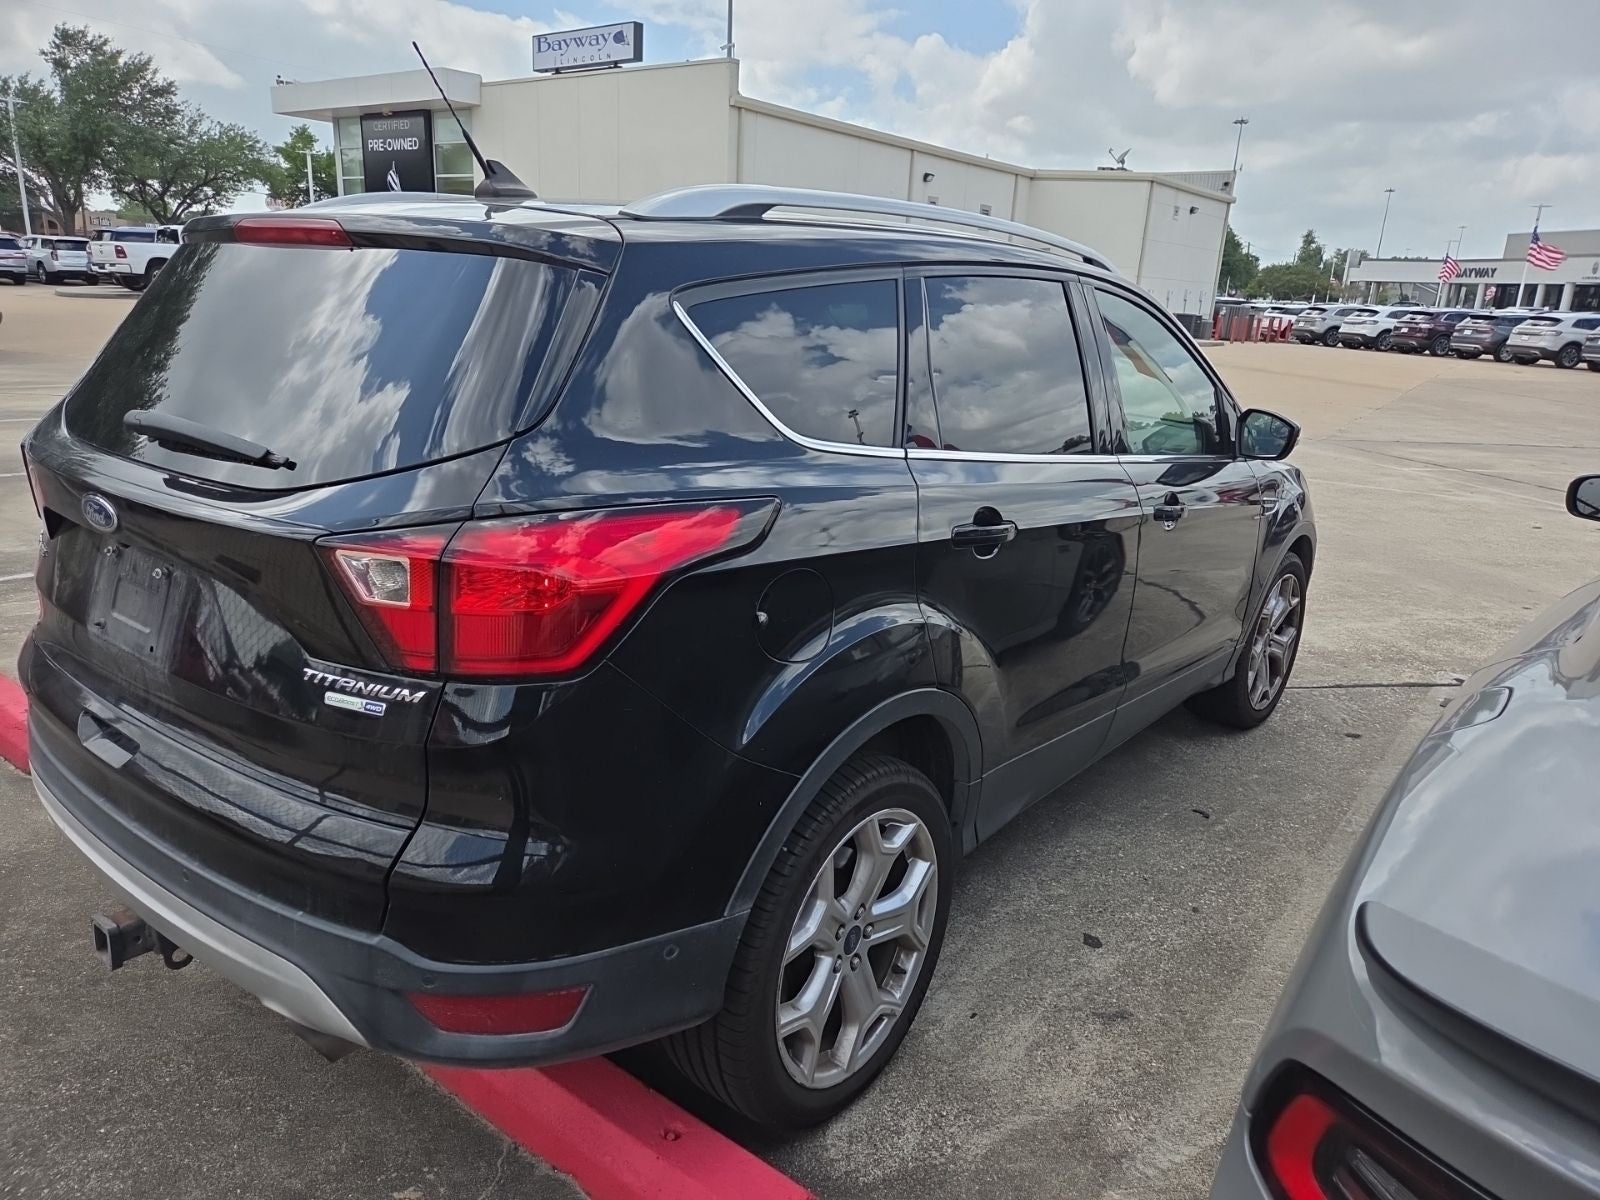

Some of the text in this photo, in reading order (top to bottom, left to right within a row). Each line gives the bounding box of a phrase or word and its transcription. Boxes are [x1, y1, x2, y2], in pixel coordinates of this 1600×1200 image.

[536, 32, 612, 56] Bayway
[560, 53, 611, 65] LINCOLN
[373, 119, 410, 131] CERTIFIED
[368, 137, 419, 151] PRE-OWNED
[86, 501, 106, 525] Ford
[303, 667, 428, 704] TITANIUM
[365, 704, 383, 713] 4WD
